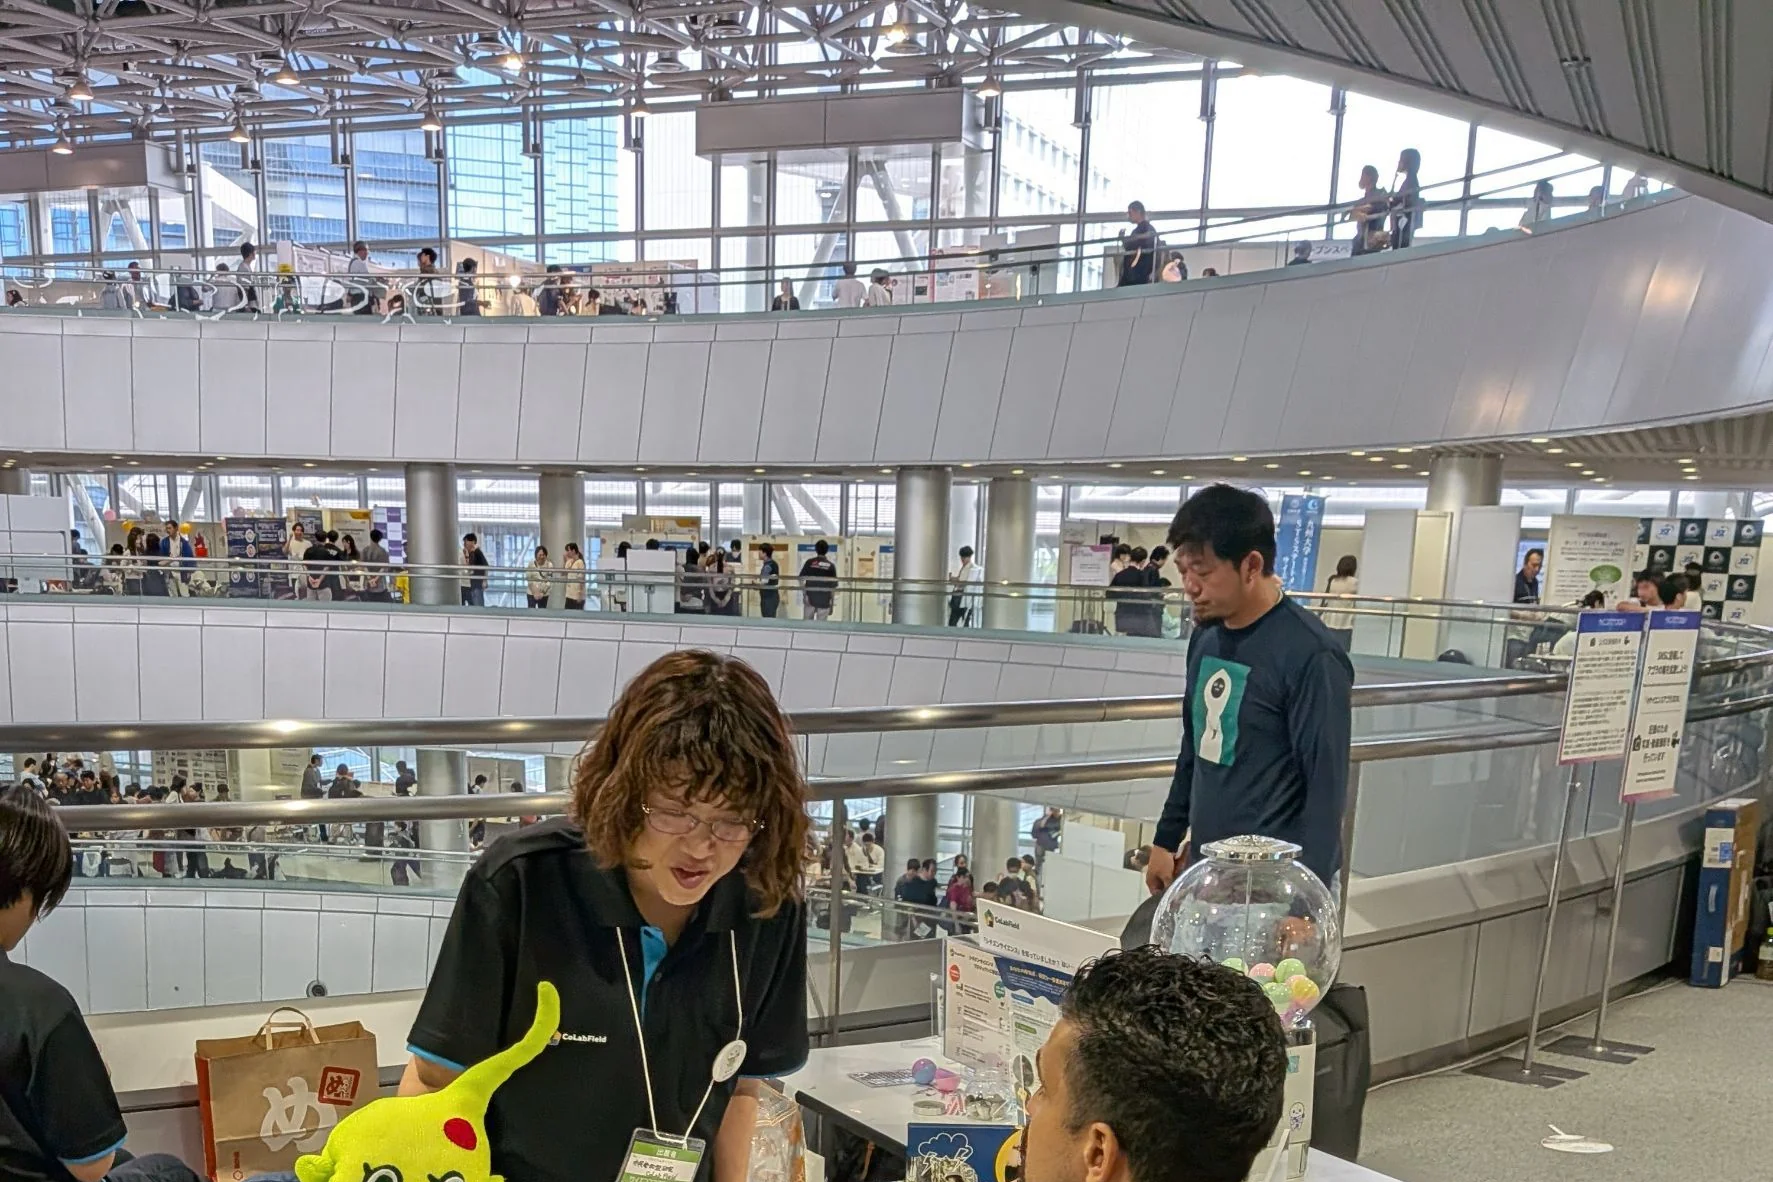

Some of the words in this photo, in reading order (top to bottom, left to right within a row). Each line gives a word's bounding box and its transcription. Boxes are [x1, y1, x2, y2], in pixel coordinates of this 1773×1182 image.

[994, 916, 1020, 930] CoLabField
[562, 1033, 607, 1043] CoLabField
[260, 1077, 339, 1152] め
